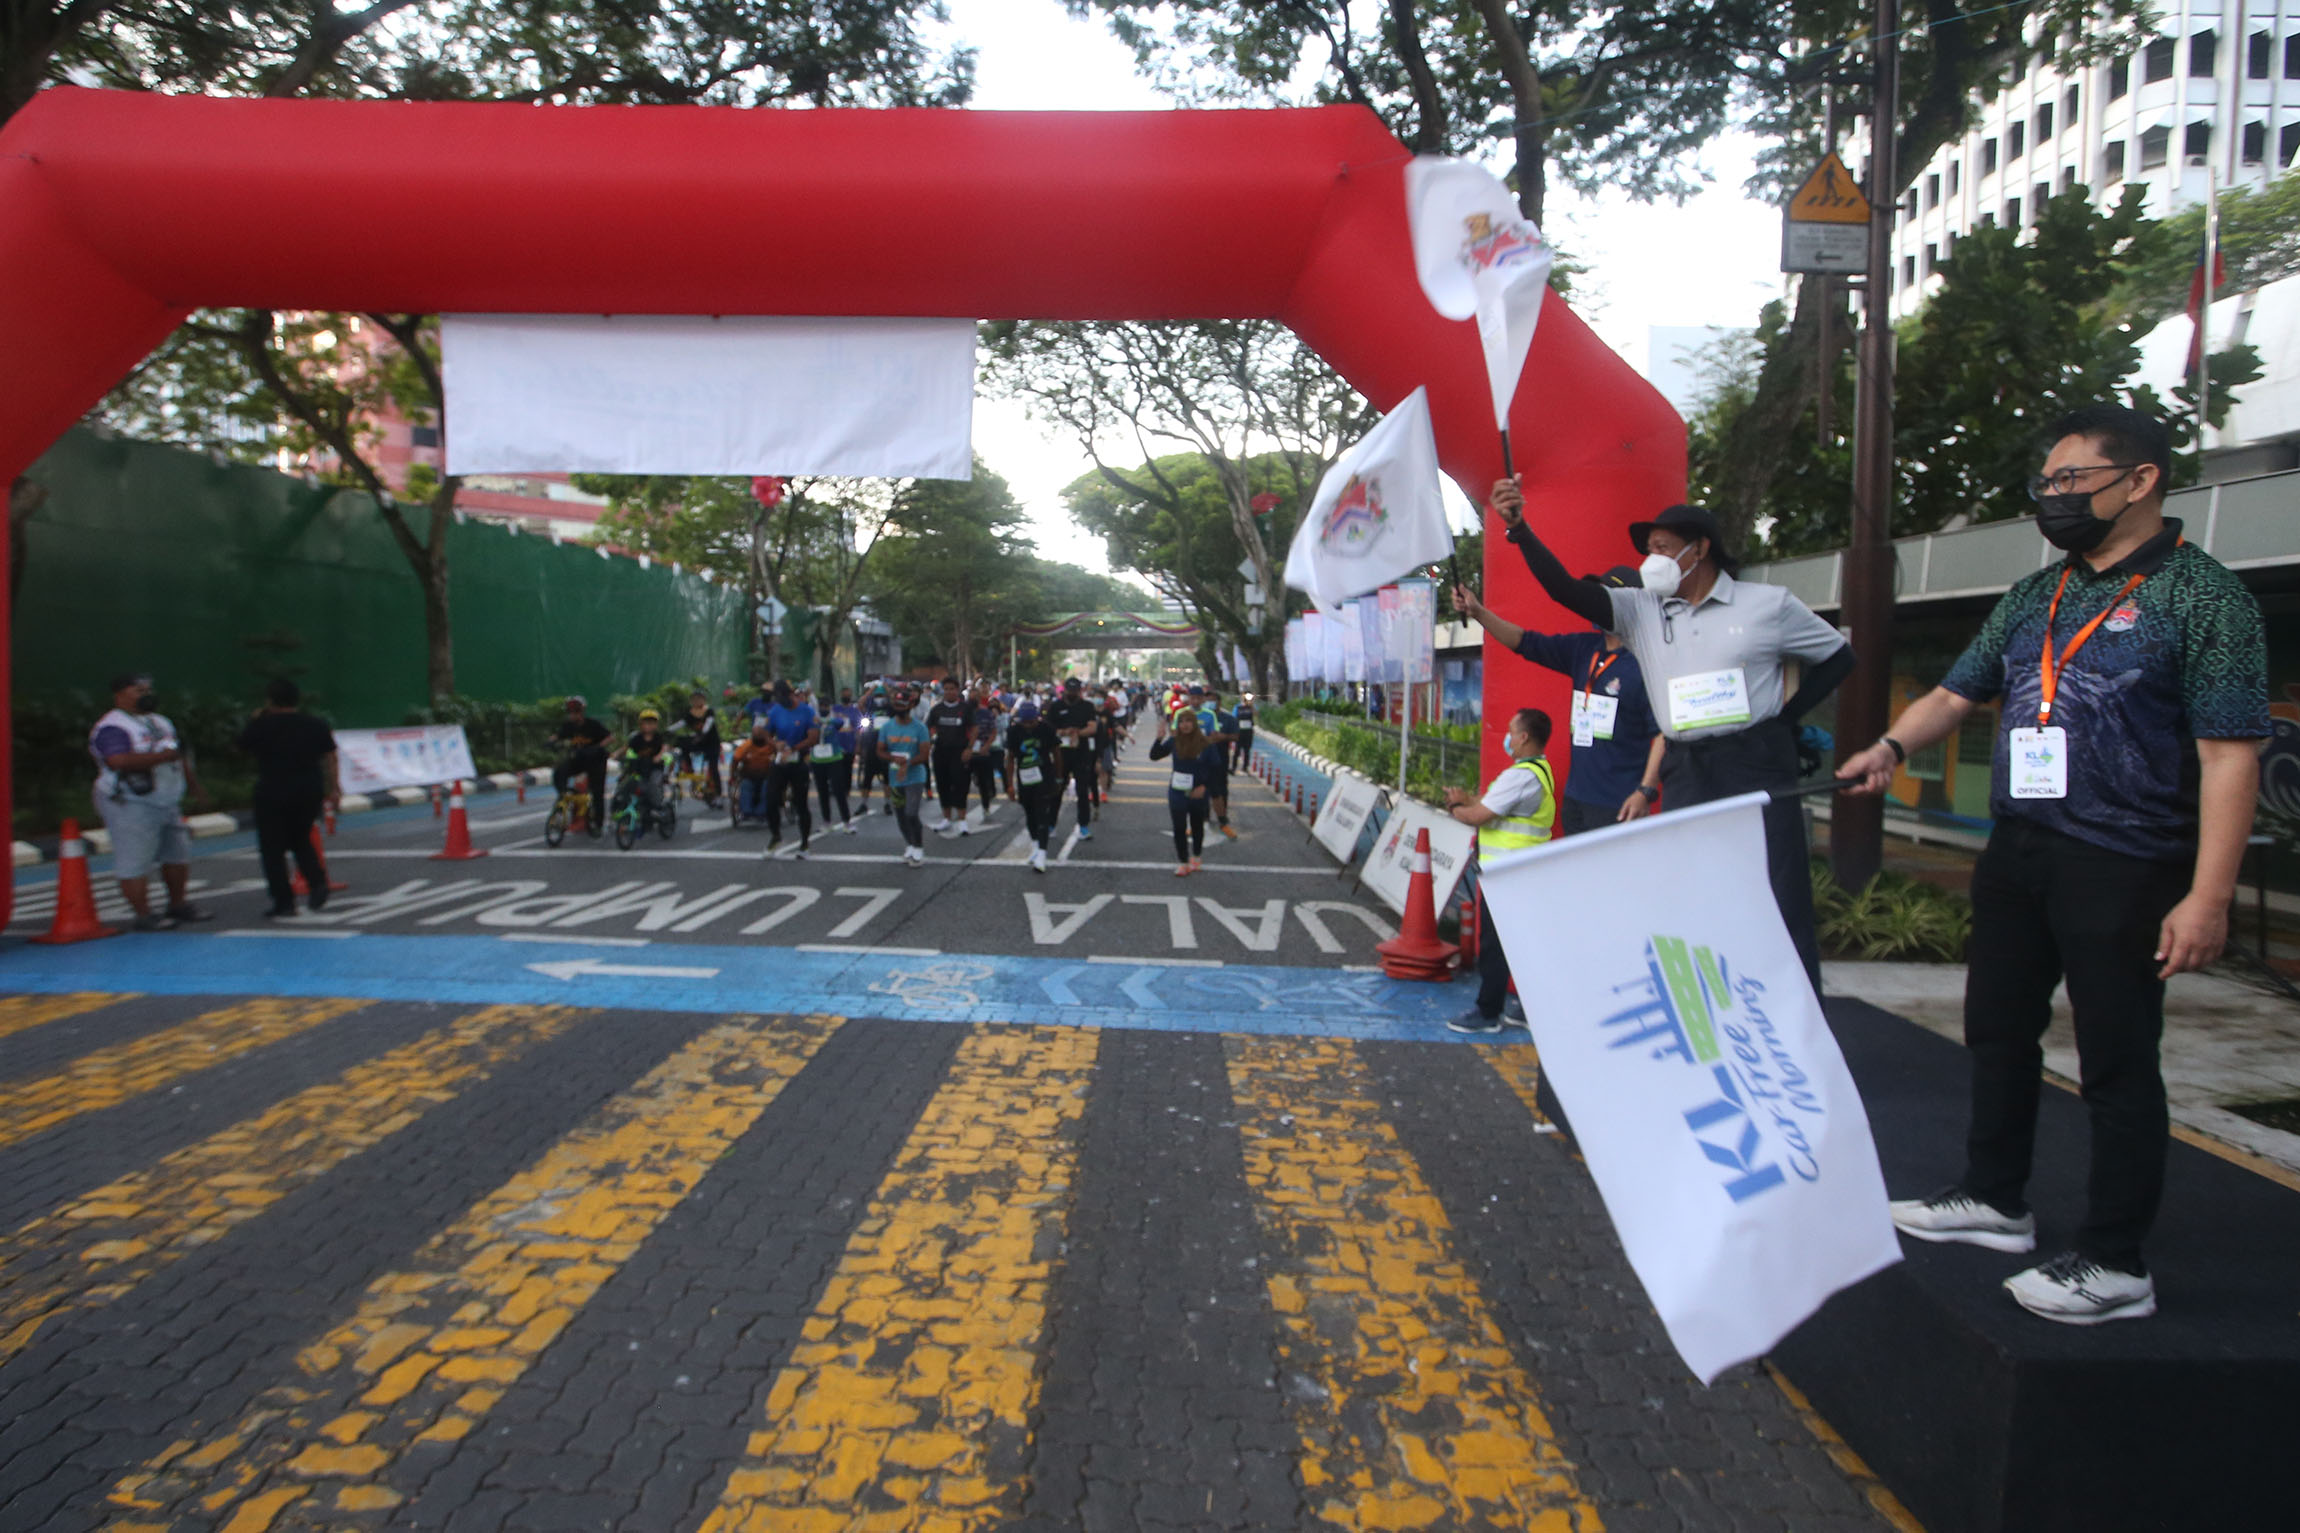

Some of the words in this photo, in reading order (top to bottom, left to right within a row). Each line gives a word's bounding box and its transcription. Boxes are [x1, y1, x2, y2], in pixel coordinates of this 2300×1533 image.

[2016, 786, 2058, 795] OFFICIAL
[272, 877, 904, 938] LUMPUR
[1022, 891, 1400, 954] UALA
[1733, 972, 1825, 1115] Morning
[1682, 1062, 1786, 1204] KL
[1724, 1022, 1820, 1183] Car-Free
